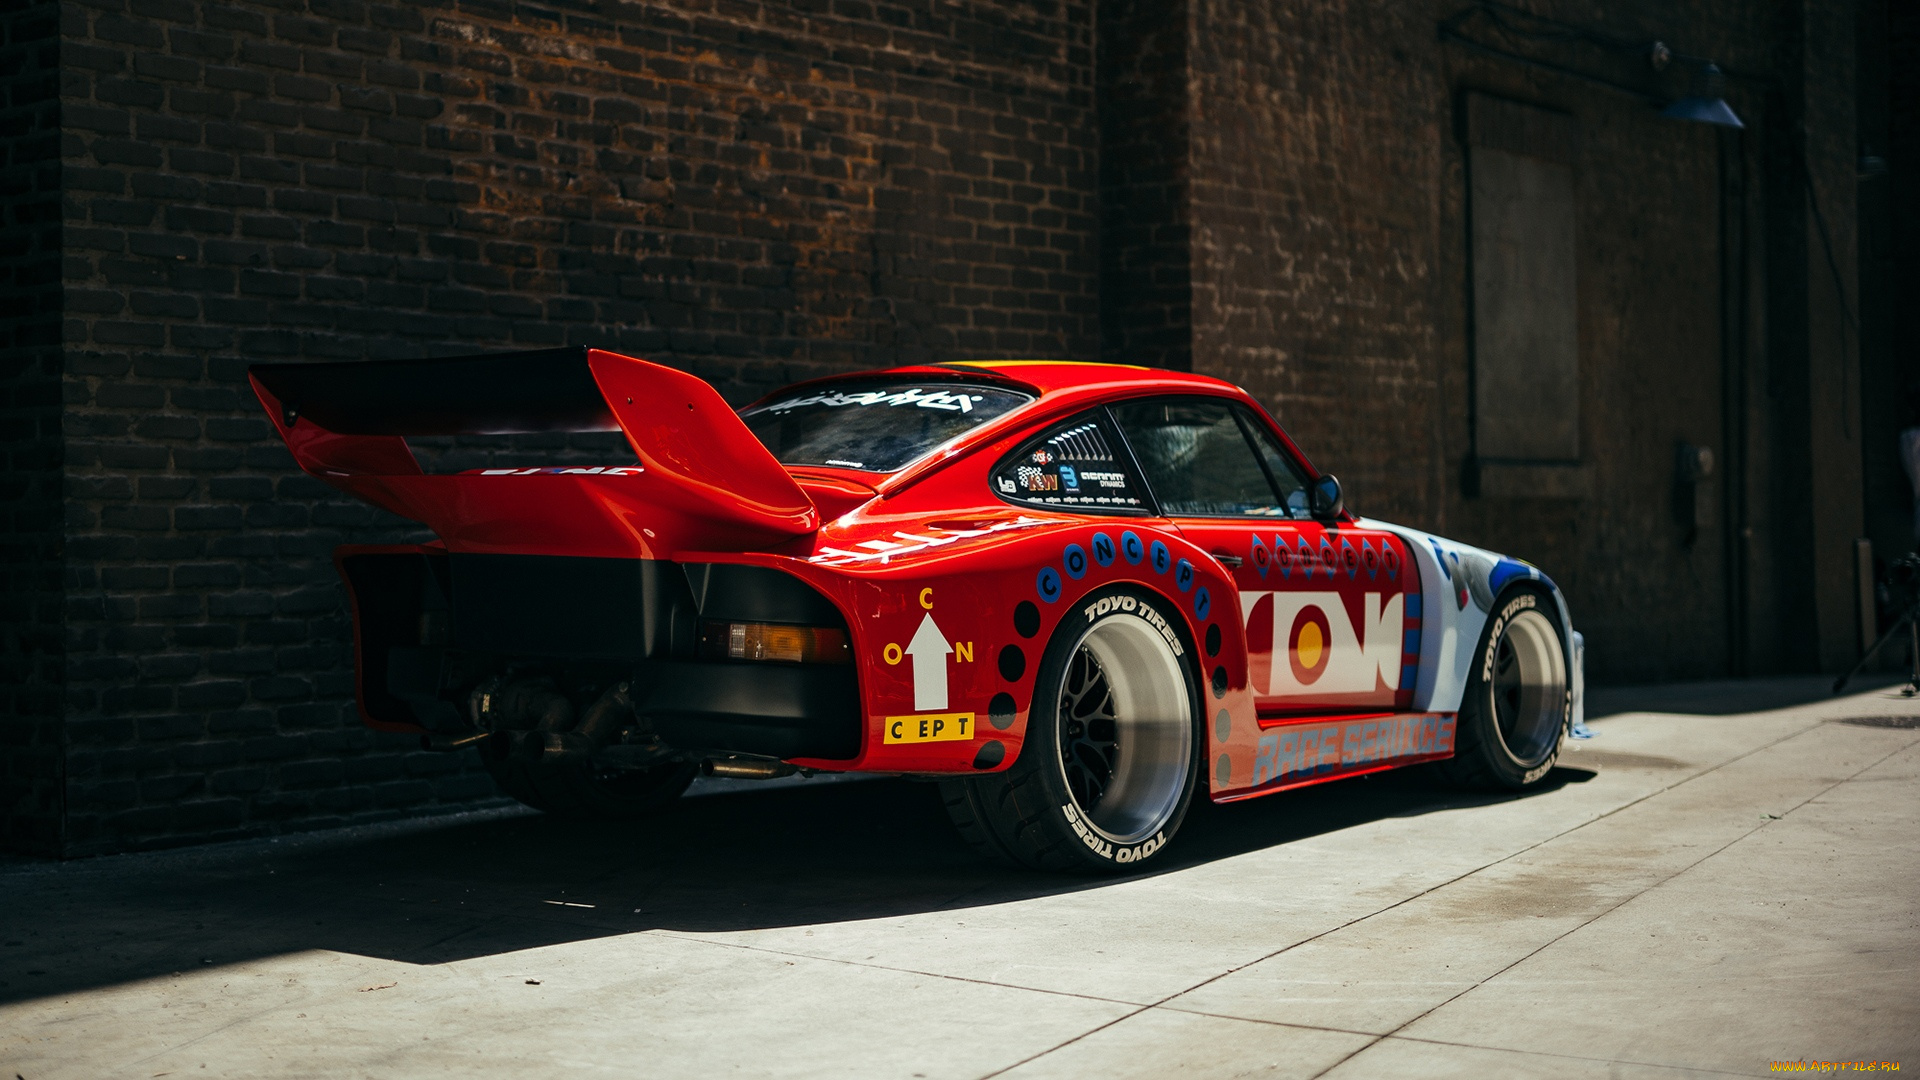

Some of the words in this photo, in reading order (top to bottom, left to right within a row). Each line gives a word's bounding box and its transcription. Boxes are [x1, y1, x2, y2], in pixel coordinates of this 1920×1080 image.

[1028, 474, 1058, 492] KW
[1042, 537, 1208, 611] CONCEPT
[1254, 545, 1394, 571] CONCEPT
[1084, 595, 1137, 623] TOYO
[1138, 601, 1184, 657] TIRES
[1482, 616, 1504, 683] TOYO
[1501, 594, 1536, 623] TIRES
[1252, 727, 1338, 787] RACE
[1062, 803, 1113, 859] TIRES
[1115, 830, 1167, 863] TOYO
